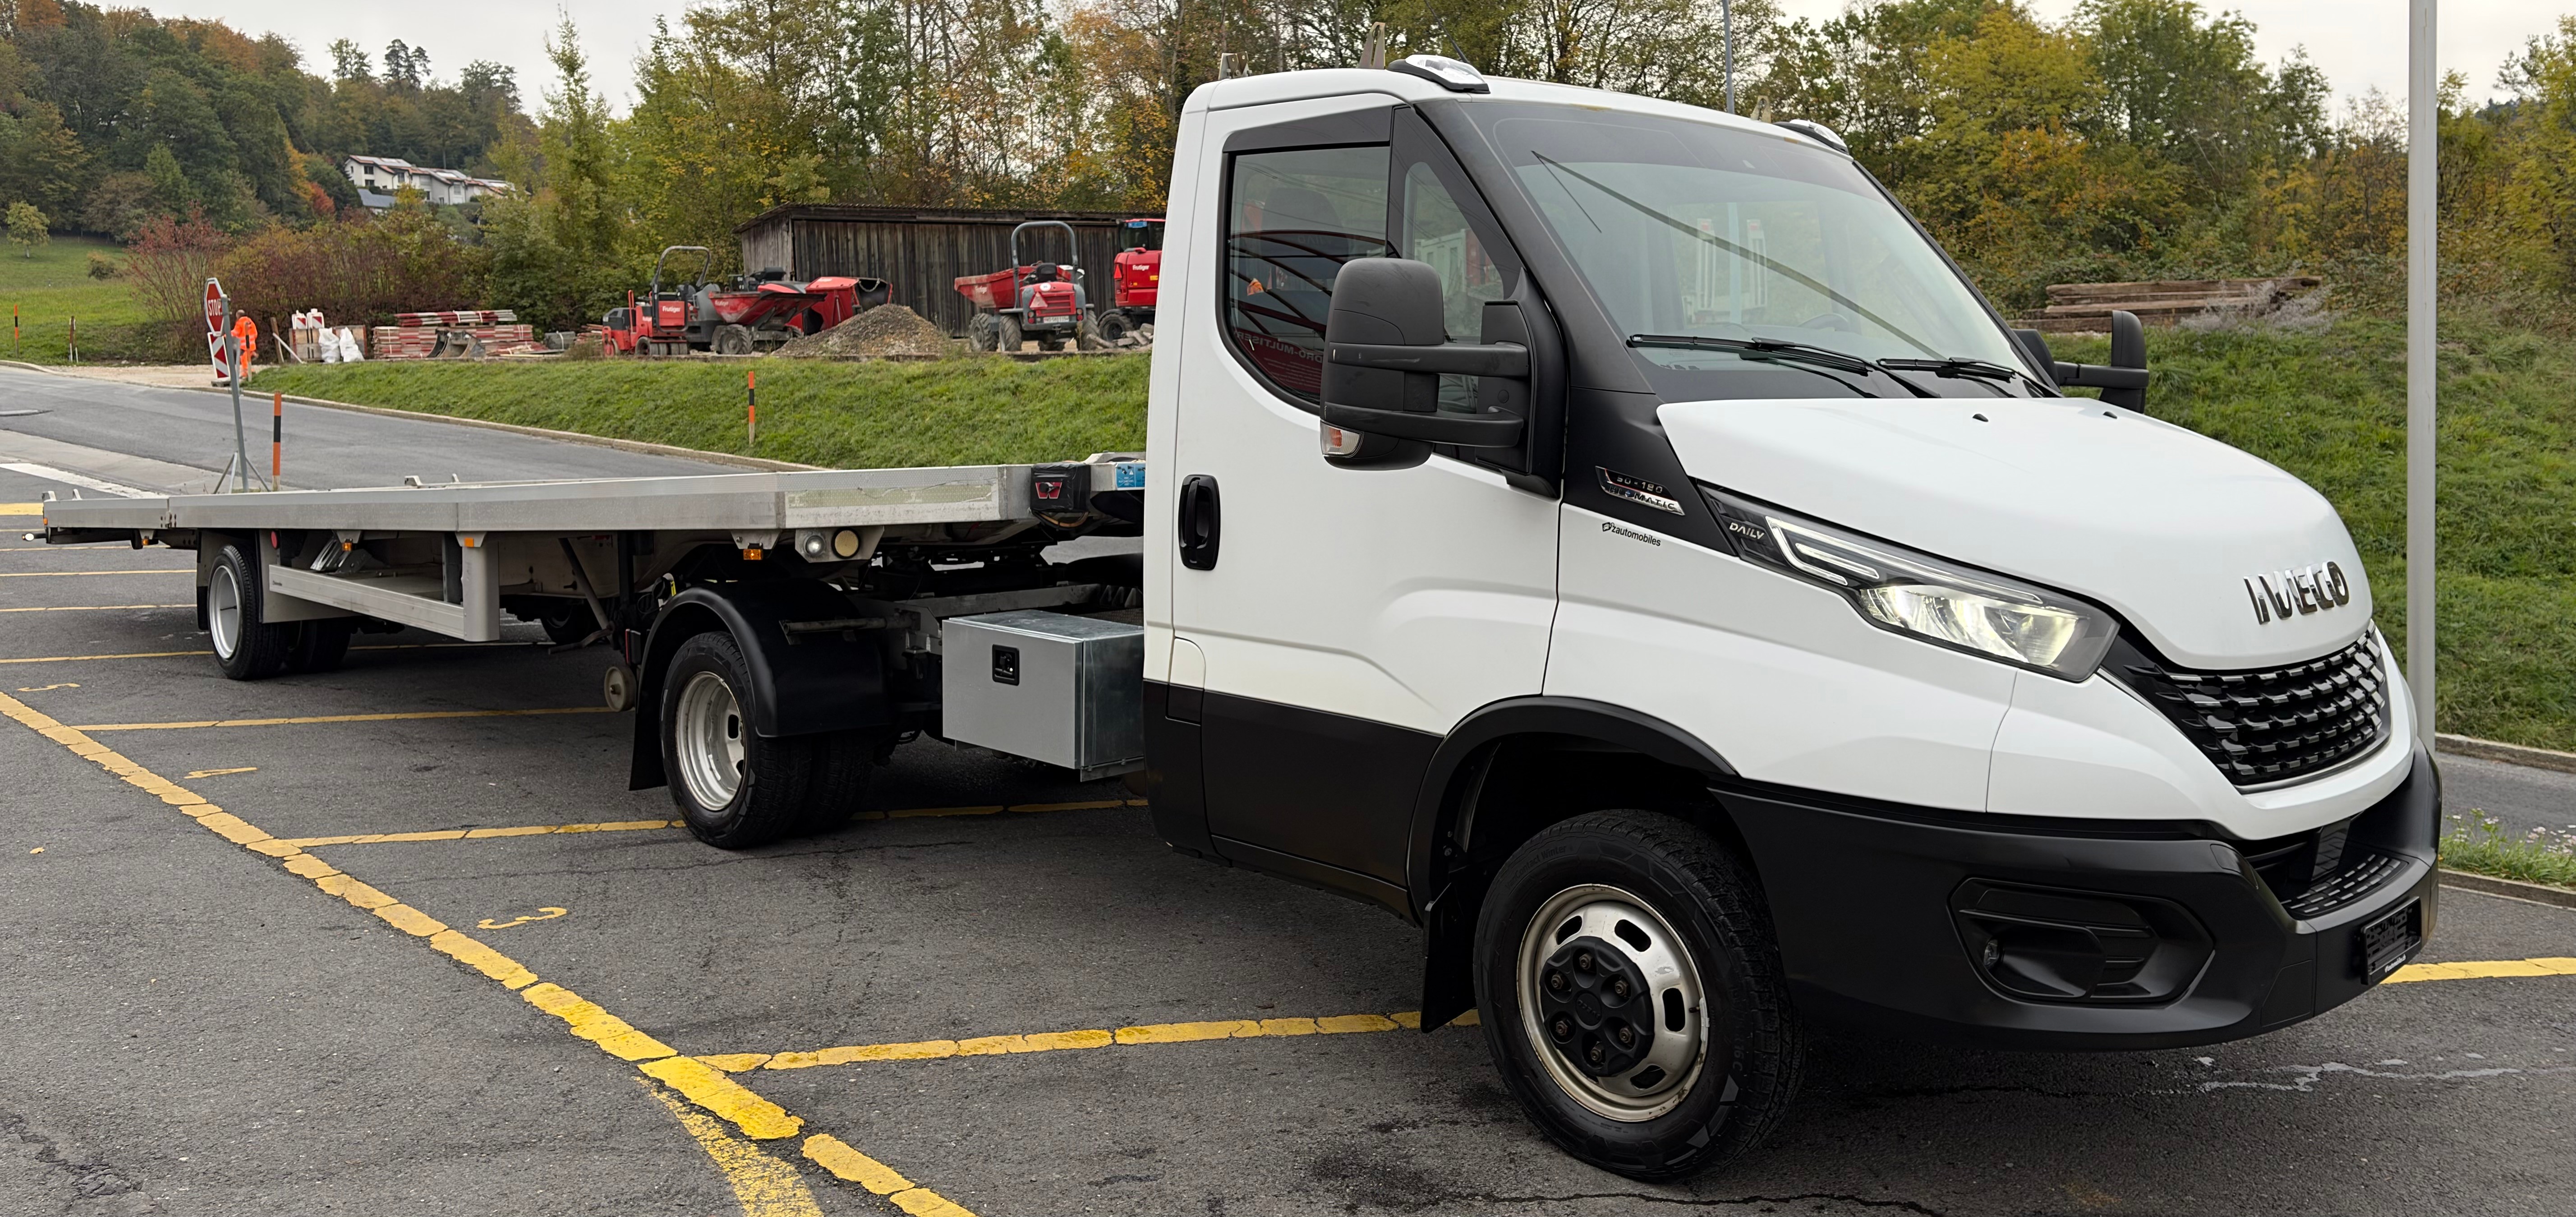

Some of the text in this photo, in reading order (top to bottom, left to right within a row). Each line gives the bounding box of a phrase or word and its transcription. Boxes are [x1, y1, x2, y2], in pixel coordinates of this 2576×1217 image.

[208, 299, 221, 316] STOP
[1611, 525, 1661, 546] zautomobiles
[1730, 522, 1764, 539] DAILY
[2243, 561, 2350, 625] IVECO
[1541, 845, 1567, 860] Winter
